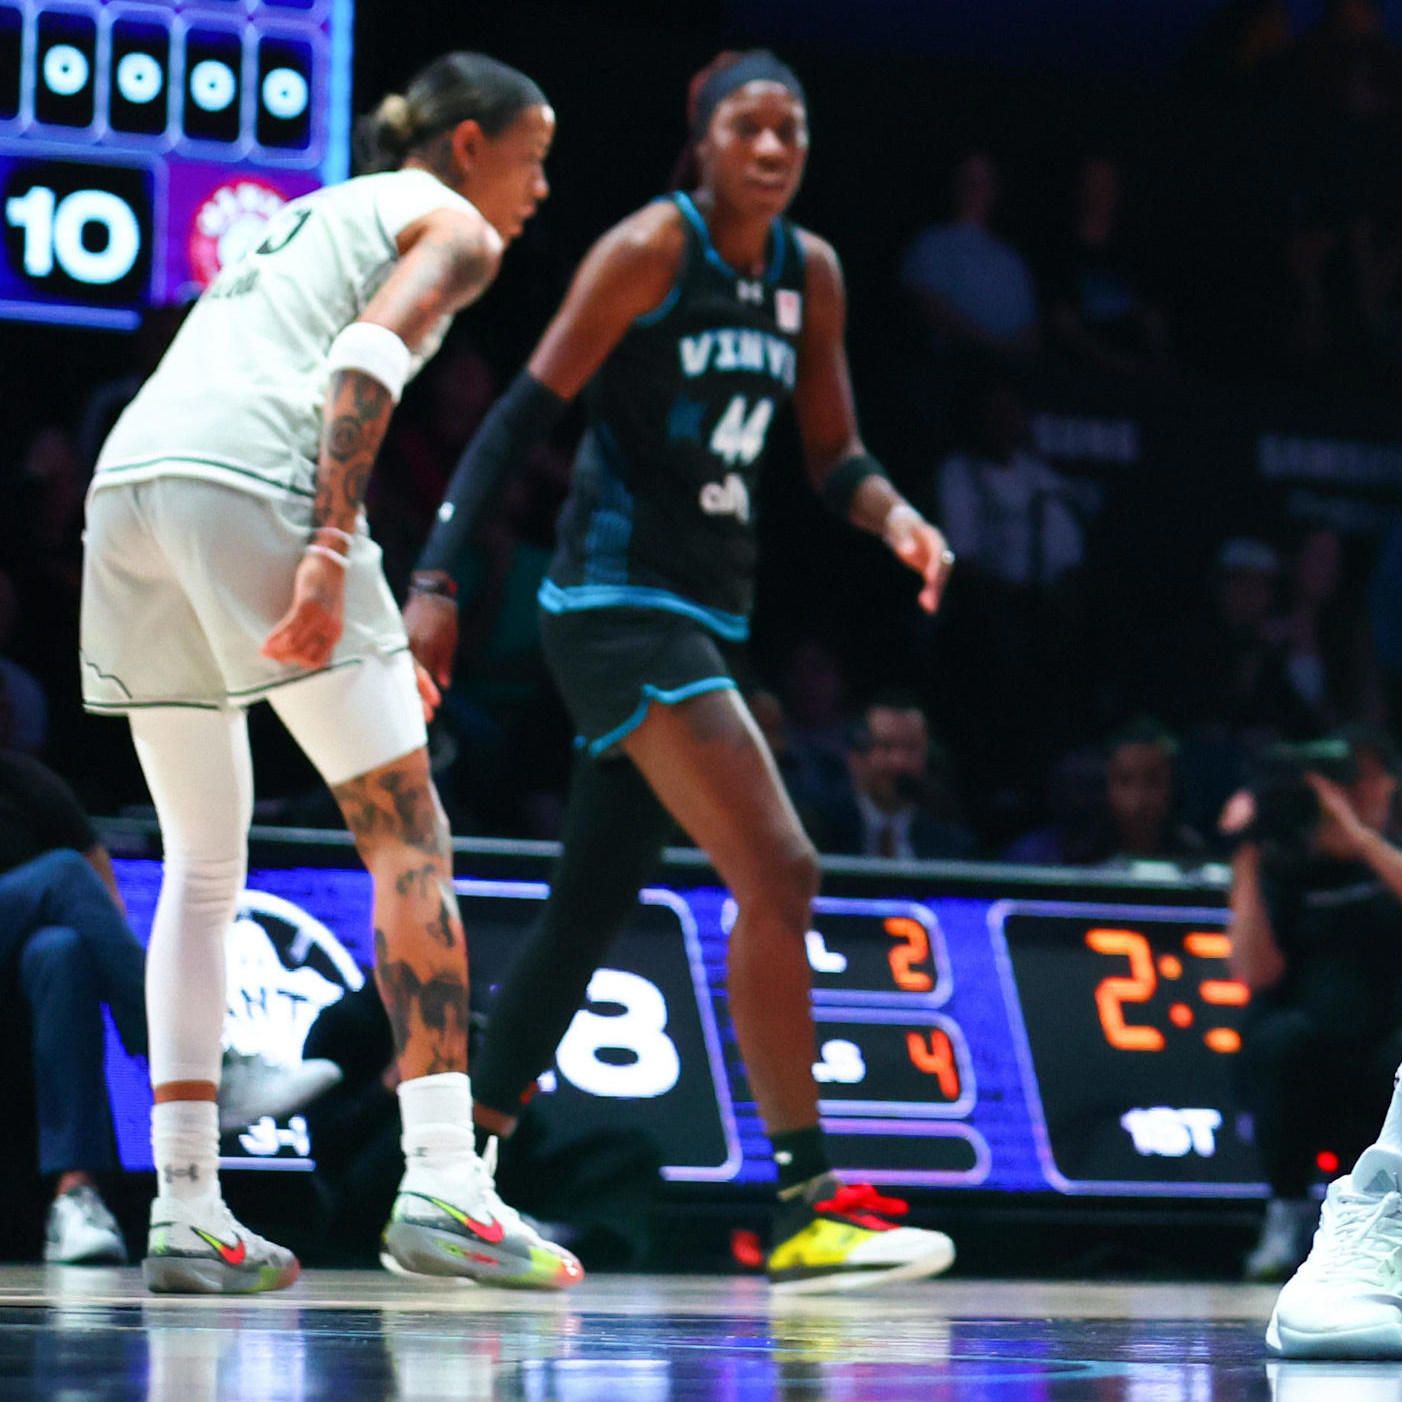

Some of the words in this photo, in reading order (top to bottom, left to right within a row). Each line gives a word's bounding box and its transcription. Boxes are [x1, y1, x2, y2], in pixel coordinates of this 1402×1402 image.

[43, 44, 90, 96] 0
[116, 52, 163, 104] 0
[190, 59, 236, 112] 0
[262, 67, 309, 120] 0
[5, 185, 141, 285] 10
[710, 395, 775, 467] 44
[882, 916, 934, 993] 2
[537, 967, 682, 1099] 8
[904, 1028, 960, 1100] 4
[1120, 1105, 1224, 1157] 1ST
